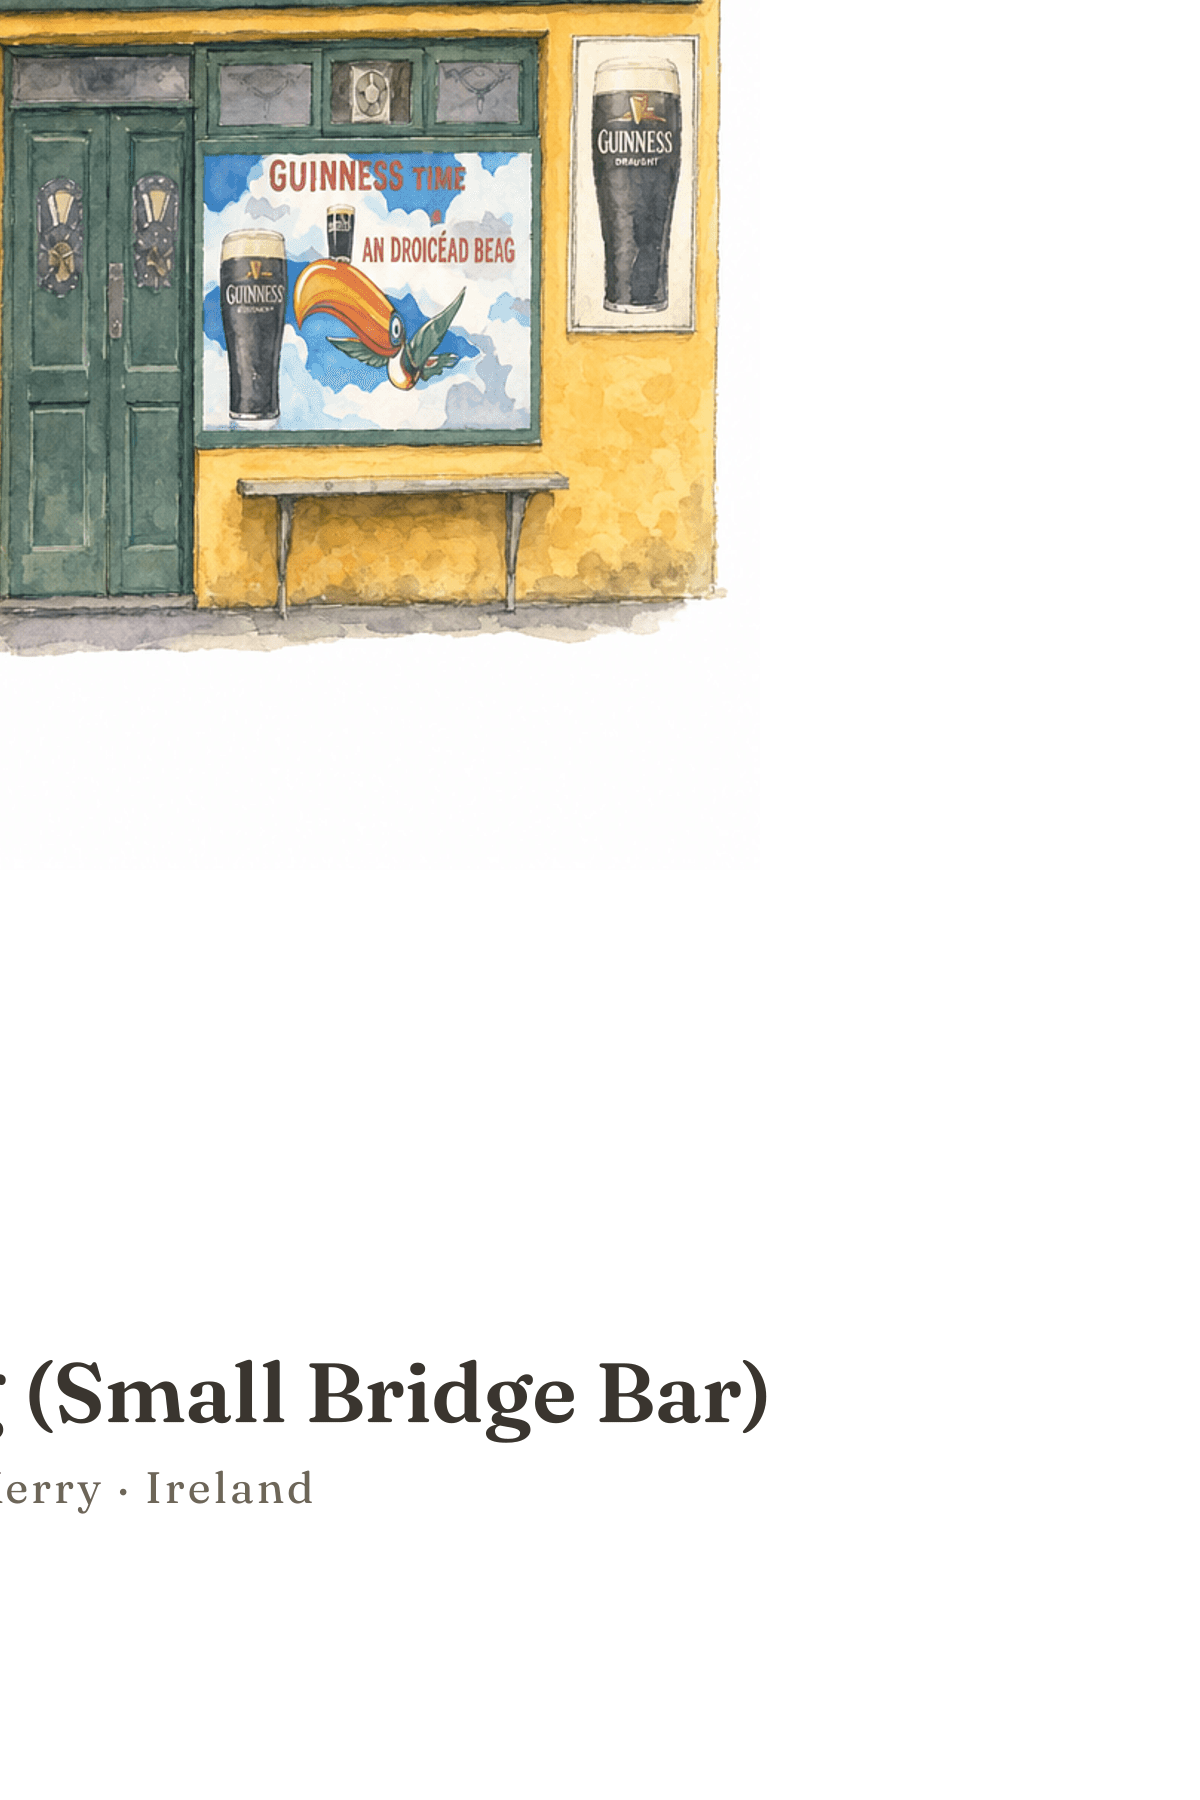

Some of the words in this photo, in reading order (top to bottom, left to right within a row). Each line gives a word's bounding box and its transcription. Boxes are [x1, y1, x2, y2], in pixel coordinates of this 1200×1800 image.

[597, 128, 673, 155] GUINNESS
[269, 158, 404, 193] GUINNESS
[412, 166, 467, 191] TIME
[362, 236, 385, 264] AN
[474, 236, 516, 264] BEAG
[225, 283, 285, 306] GUINNESS
